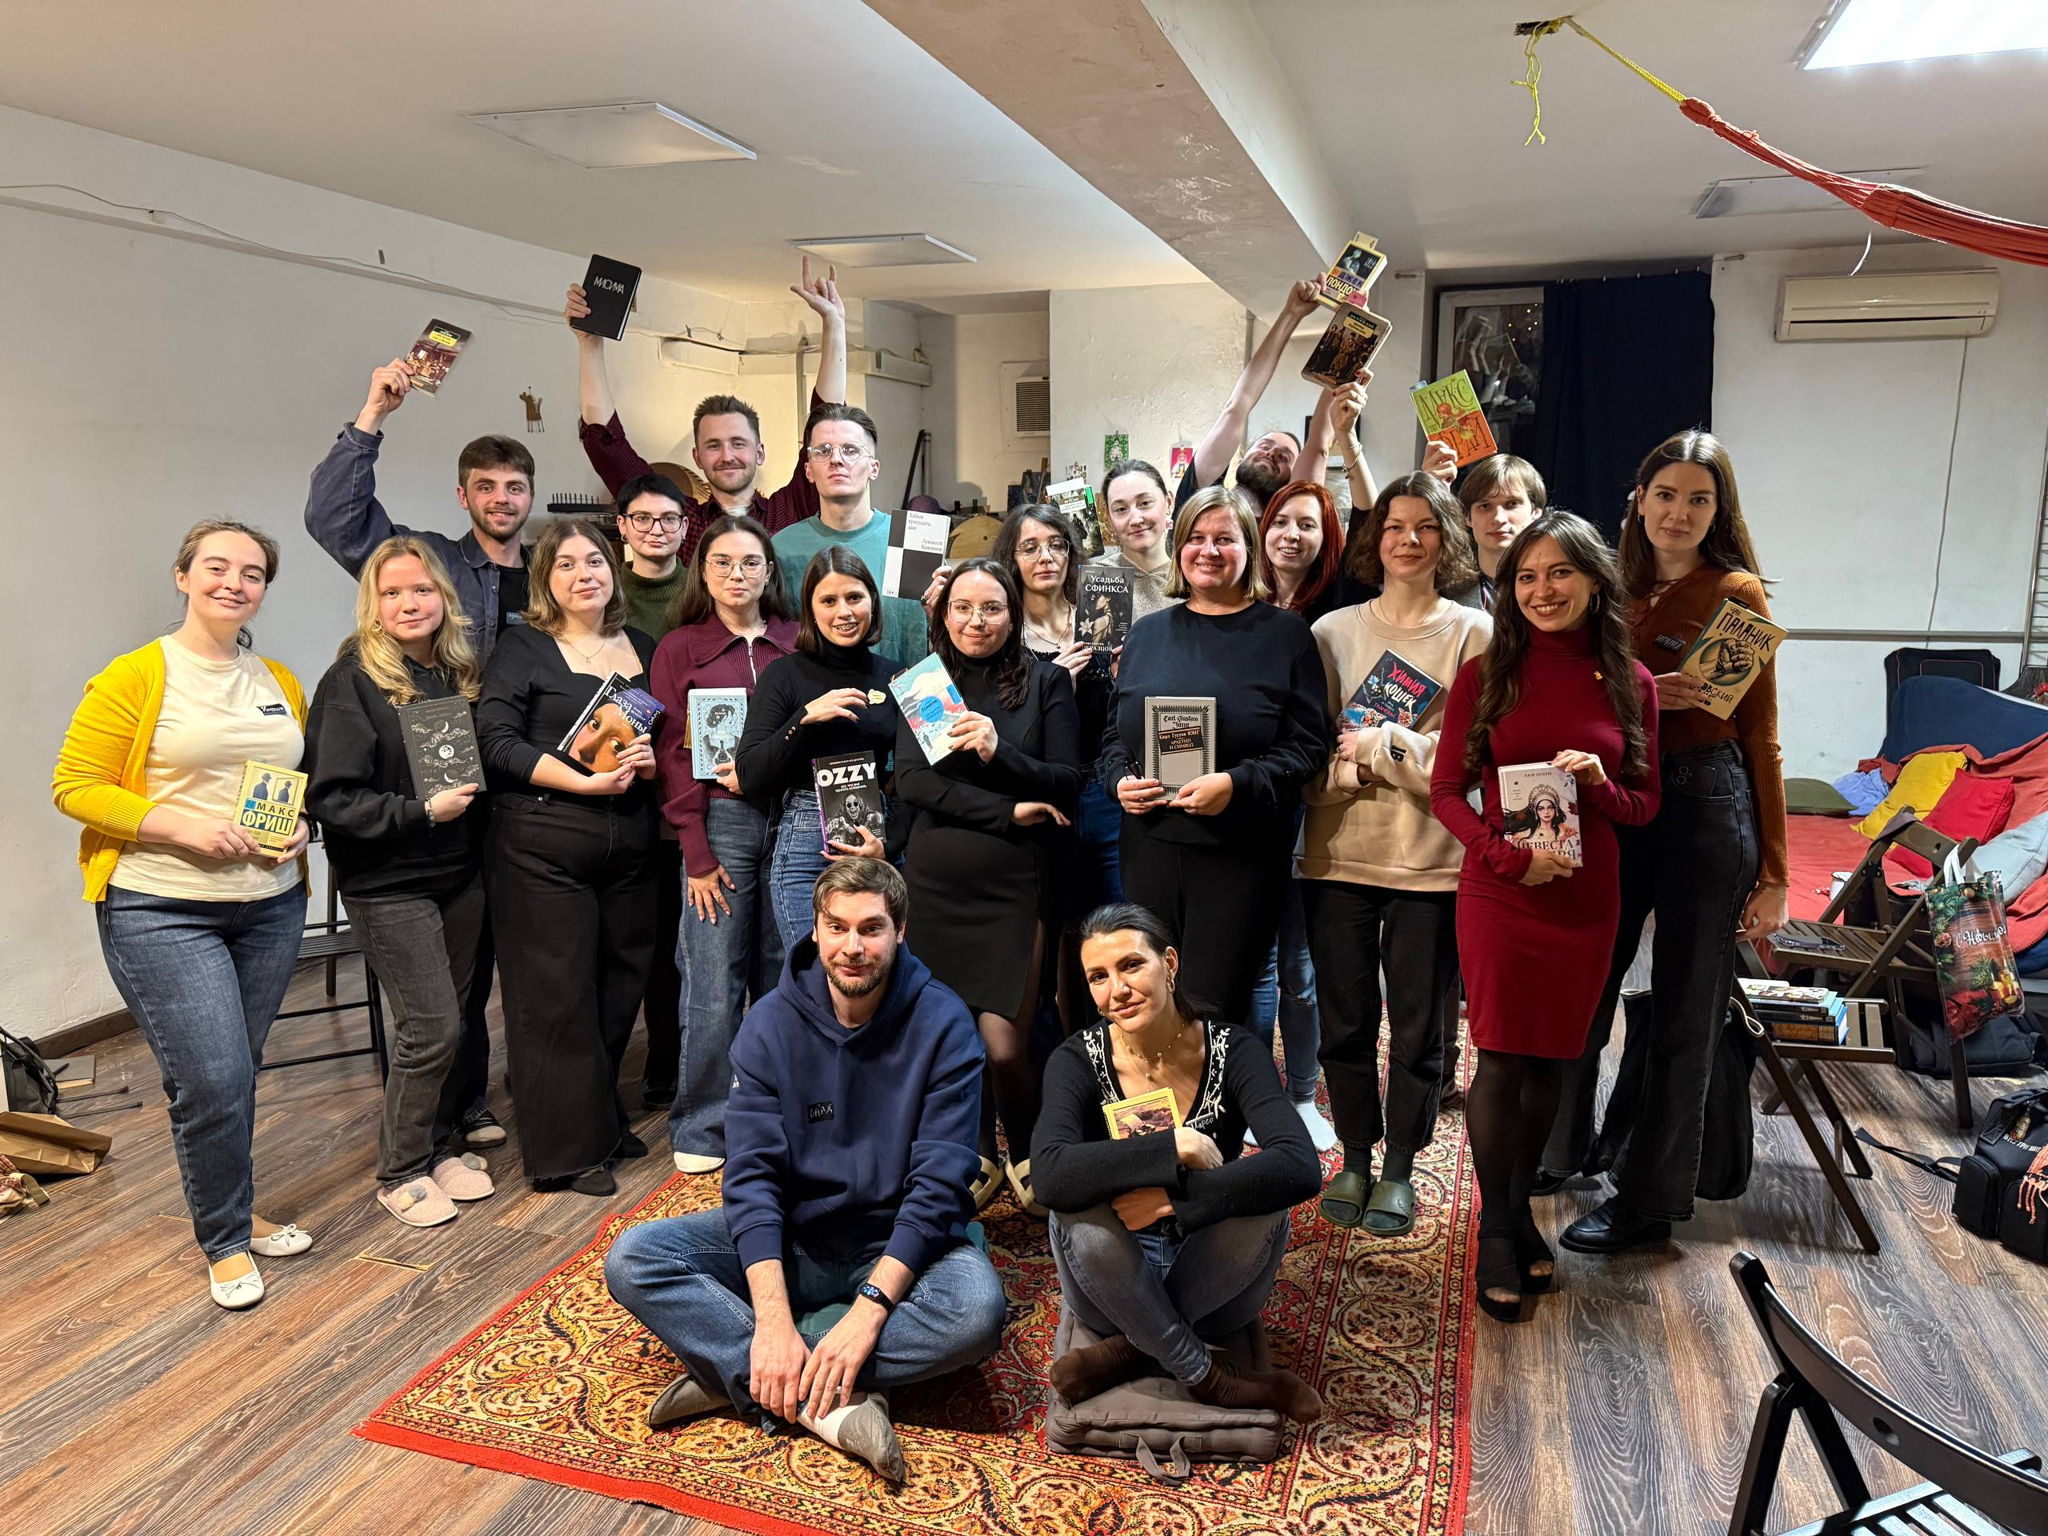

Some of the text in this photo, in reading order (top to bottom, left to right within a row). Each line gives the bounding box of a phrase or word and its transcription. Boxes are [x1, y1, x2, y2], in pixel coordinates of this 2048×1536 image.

[593, 276, 625, 294] МИСИМА
[1085, 584, 1129, 593] СФИНКСА
[1090, 575, 1125, 584] Усадьба
[1716, 612, 1776, 652] ПАЛАНИК
[1387, 661, 1428, 698] ХИМИЯ
[604, 686, 633, 712] Глаза
[1384, 682, 1417, 717] КОШЕК
[617, 704, 648, 733] Моны
[1163, 715, 1176, 723] Carl
[816, 762, 876, 787] OZZY
[256, 802, 295, 817] МАКС
[242, 810, 293, 835] ФРИШ
